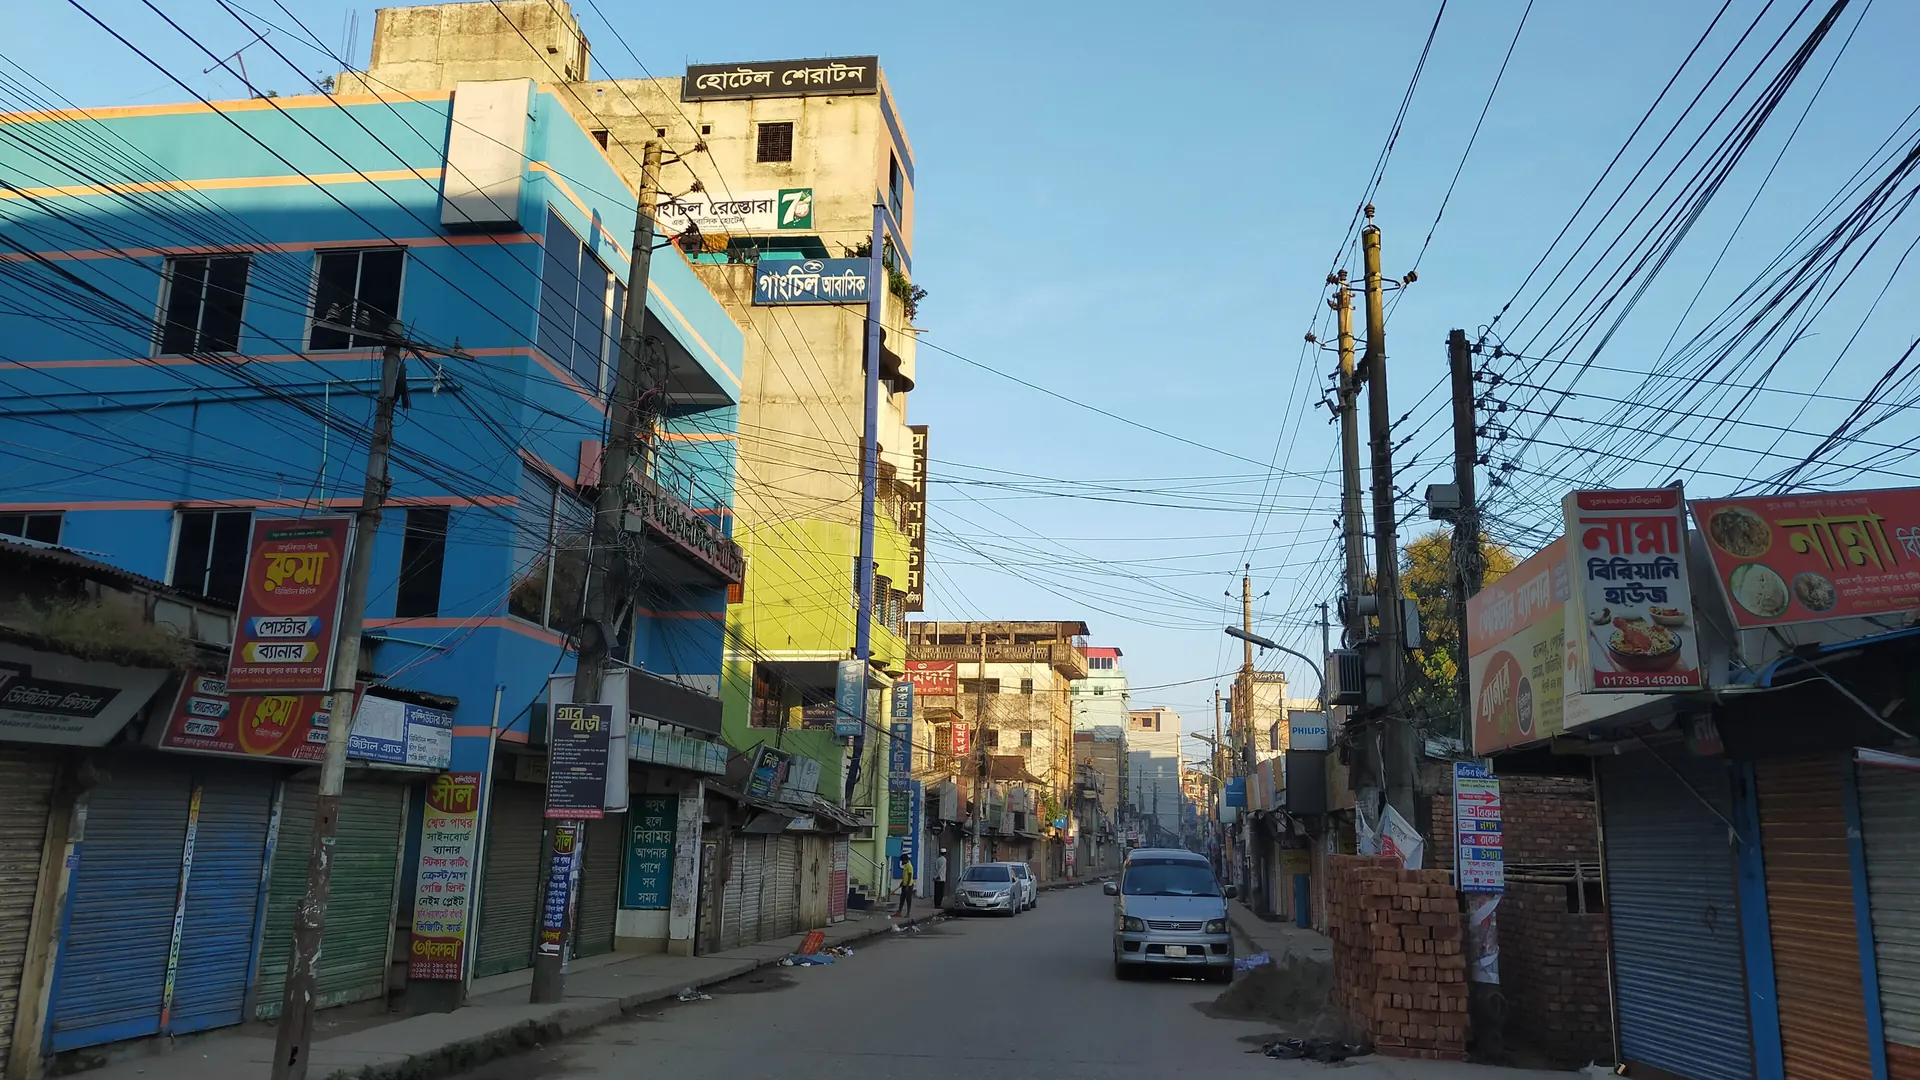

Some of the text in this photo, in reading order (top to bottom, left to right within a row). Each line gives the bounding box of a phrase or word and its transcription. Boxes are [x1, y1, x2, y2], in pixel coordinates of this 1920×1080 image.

[696, 63, 866, 91] হোটেল শেরাটন
[657, 198, 776, 218] াংচিল রেস্তোরা
[759, 266, 865, 299] গাংচিল আবাসিক
[1579, 516, 1679, 554] নান্না
[1774, 507, 1899, 573] নান্না
[263, 552, 329, 592] রুমা
[1587, 557, 1680, 581] বিরিয়ানি
[1604, 582, 1668, 606] হাউজ
[259, 617, 307, 635] পোস্টার
[258, 644, 304, 660] ব্যানার
[896, 663, 955, 686] হামদর্দ
[1603, 675, 1689, 685] 01739-146200
[4, 685, 63, 707] ডিজিটাল
[1480, 659, 1511, 723] ব্যানার
[1292, 727, 1326, 735] PHILIPS
[348, 736, 378, 751] জিটাল
[762, 752, 779, 768] নিউ
[431, 775, 475, 811] সীল
[427, 817, 473, 830] শ্বেত পাথর
[645, 816, 663, 827] হলে
[427, 831, 471, 842] সাইনবোর্ড
[633, 825, 673, 844] নিরাময়
[433, 846, 461, 855] ব্যানার
[635, 847, 668, 859] আপনার
[422, 856, 469, 868] স্টিকার কাটিং
[640, 862, 662, 874] পাশে
[421, 870, 468, 882] ক্রেস্ট/মগ
[642, 877, 656, 888] সব
[420, 881, 466, 893] গেঞ্জি প্রিন্ট
[418, 895, 465, 907] নেইম প্লেইট
[638, 892, 659, 904] সময়
[416, 921, 462, 932] ভিজিটিং কার্ড
[413, 939, 462, 960] আলপনা
